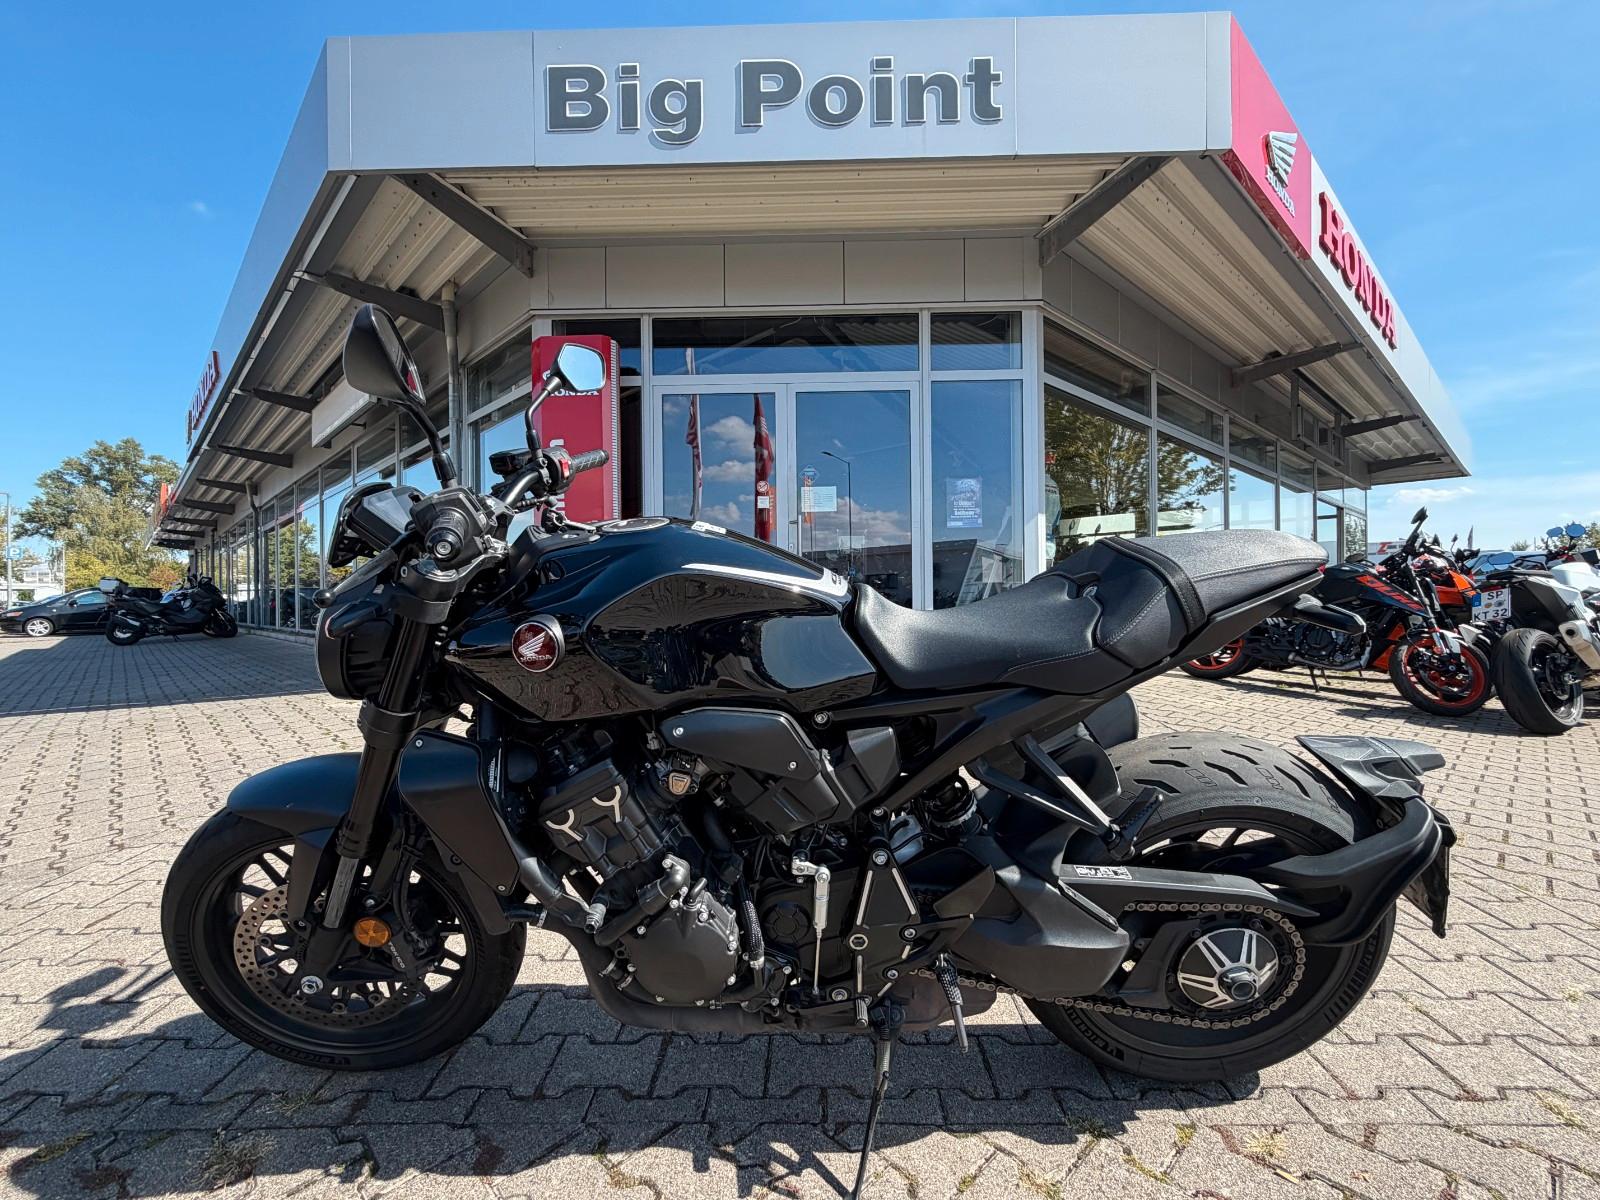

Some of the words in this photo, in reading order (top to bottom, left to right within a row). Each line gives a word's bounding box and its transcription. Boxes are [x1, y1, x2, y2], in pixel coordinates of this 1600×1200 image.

[544, 63, 704, 145] Big
[738, 55, 1003, 127] Point
[1264, 163, 1296, 217] HONDA
[1318, 191, 1398, 351] HONDA
[1487, 590, 1503, 600] SP
[1473, 610, 1489, 621] KT
[1492, 608, 1508, 618] 32
[520, 654, 552, 662] HONDA
